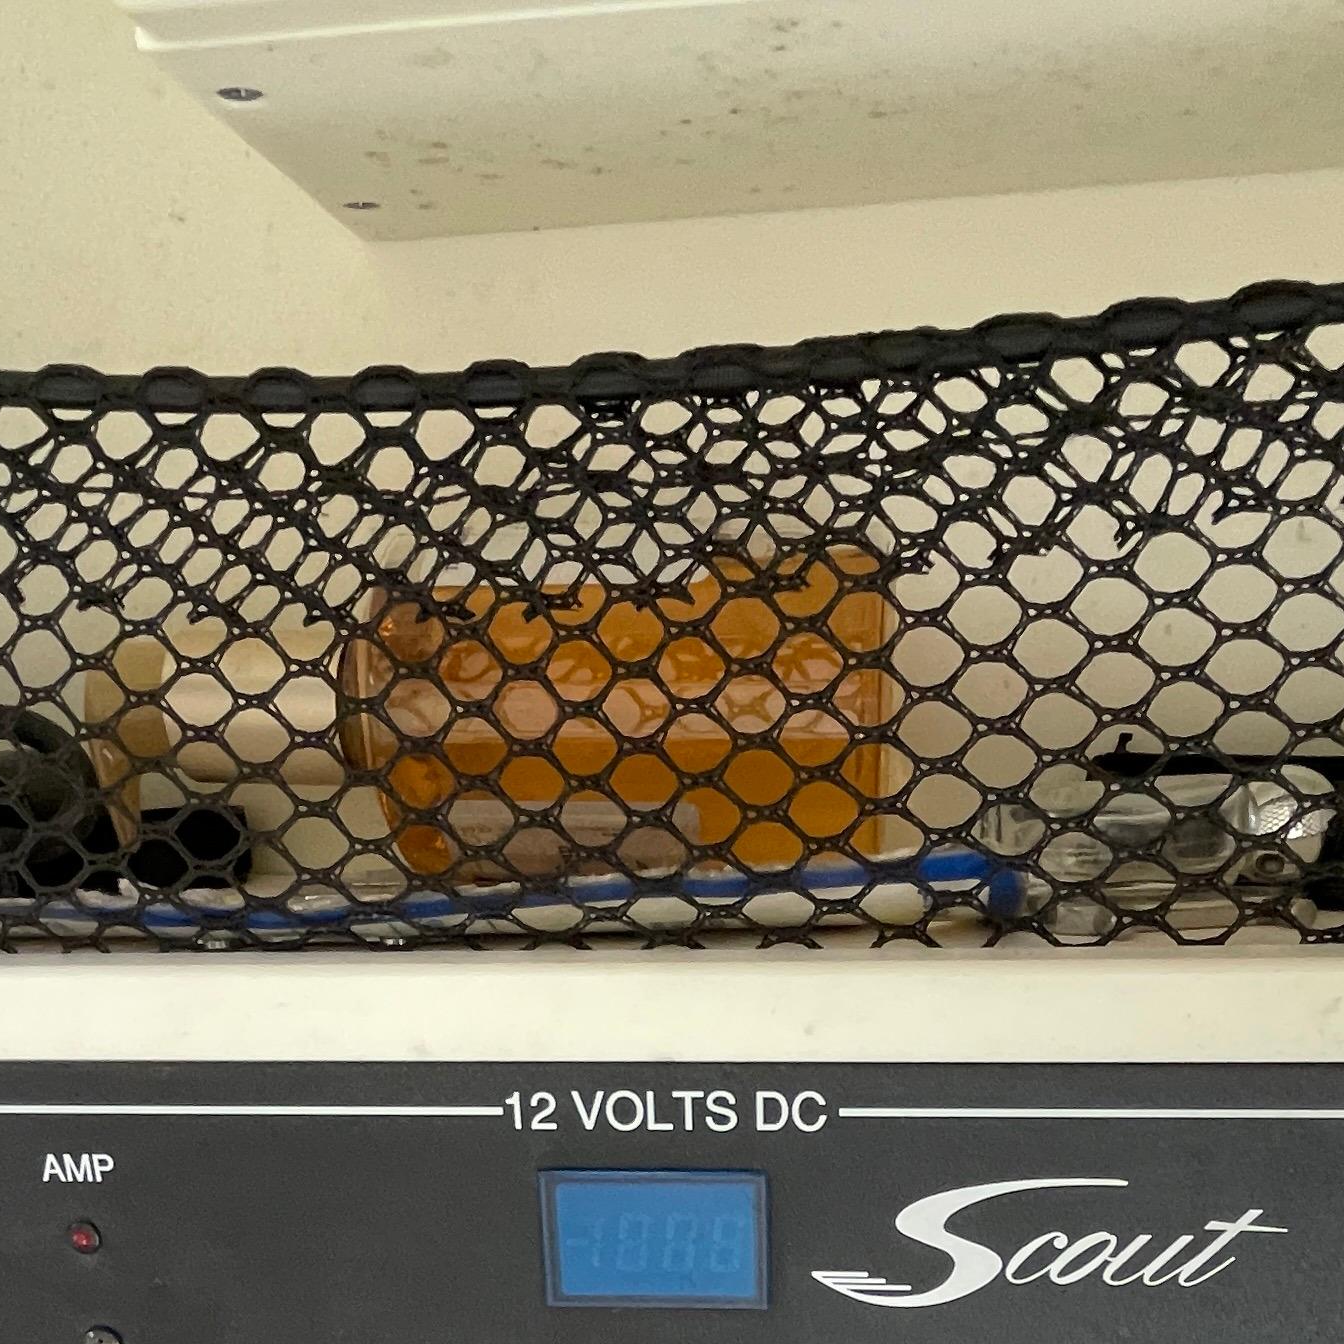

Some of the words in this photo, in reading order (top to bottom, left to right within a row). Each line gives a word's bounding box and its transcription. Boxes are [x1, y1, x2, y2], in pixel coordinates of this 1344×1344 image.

[500, 1092, 557, 1129] 12
[571, 1090, 737, 1131] VOLTS
[756, 1091, 827, 1132] DC
[43, 1154, 113, 1182] AMP
[811, 1178, 1288, 1307] Scout
